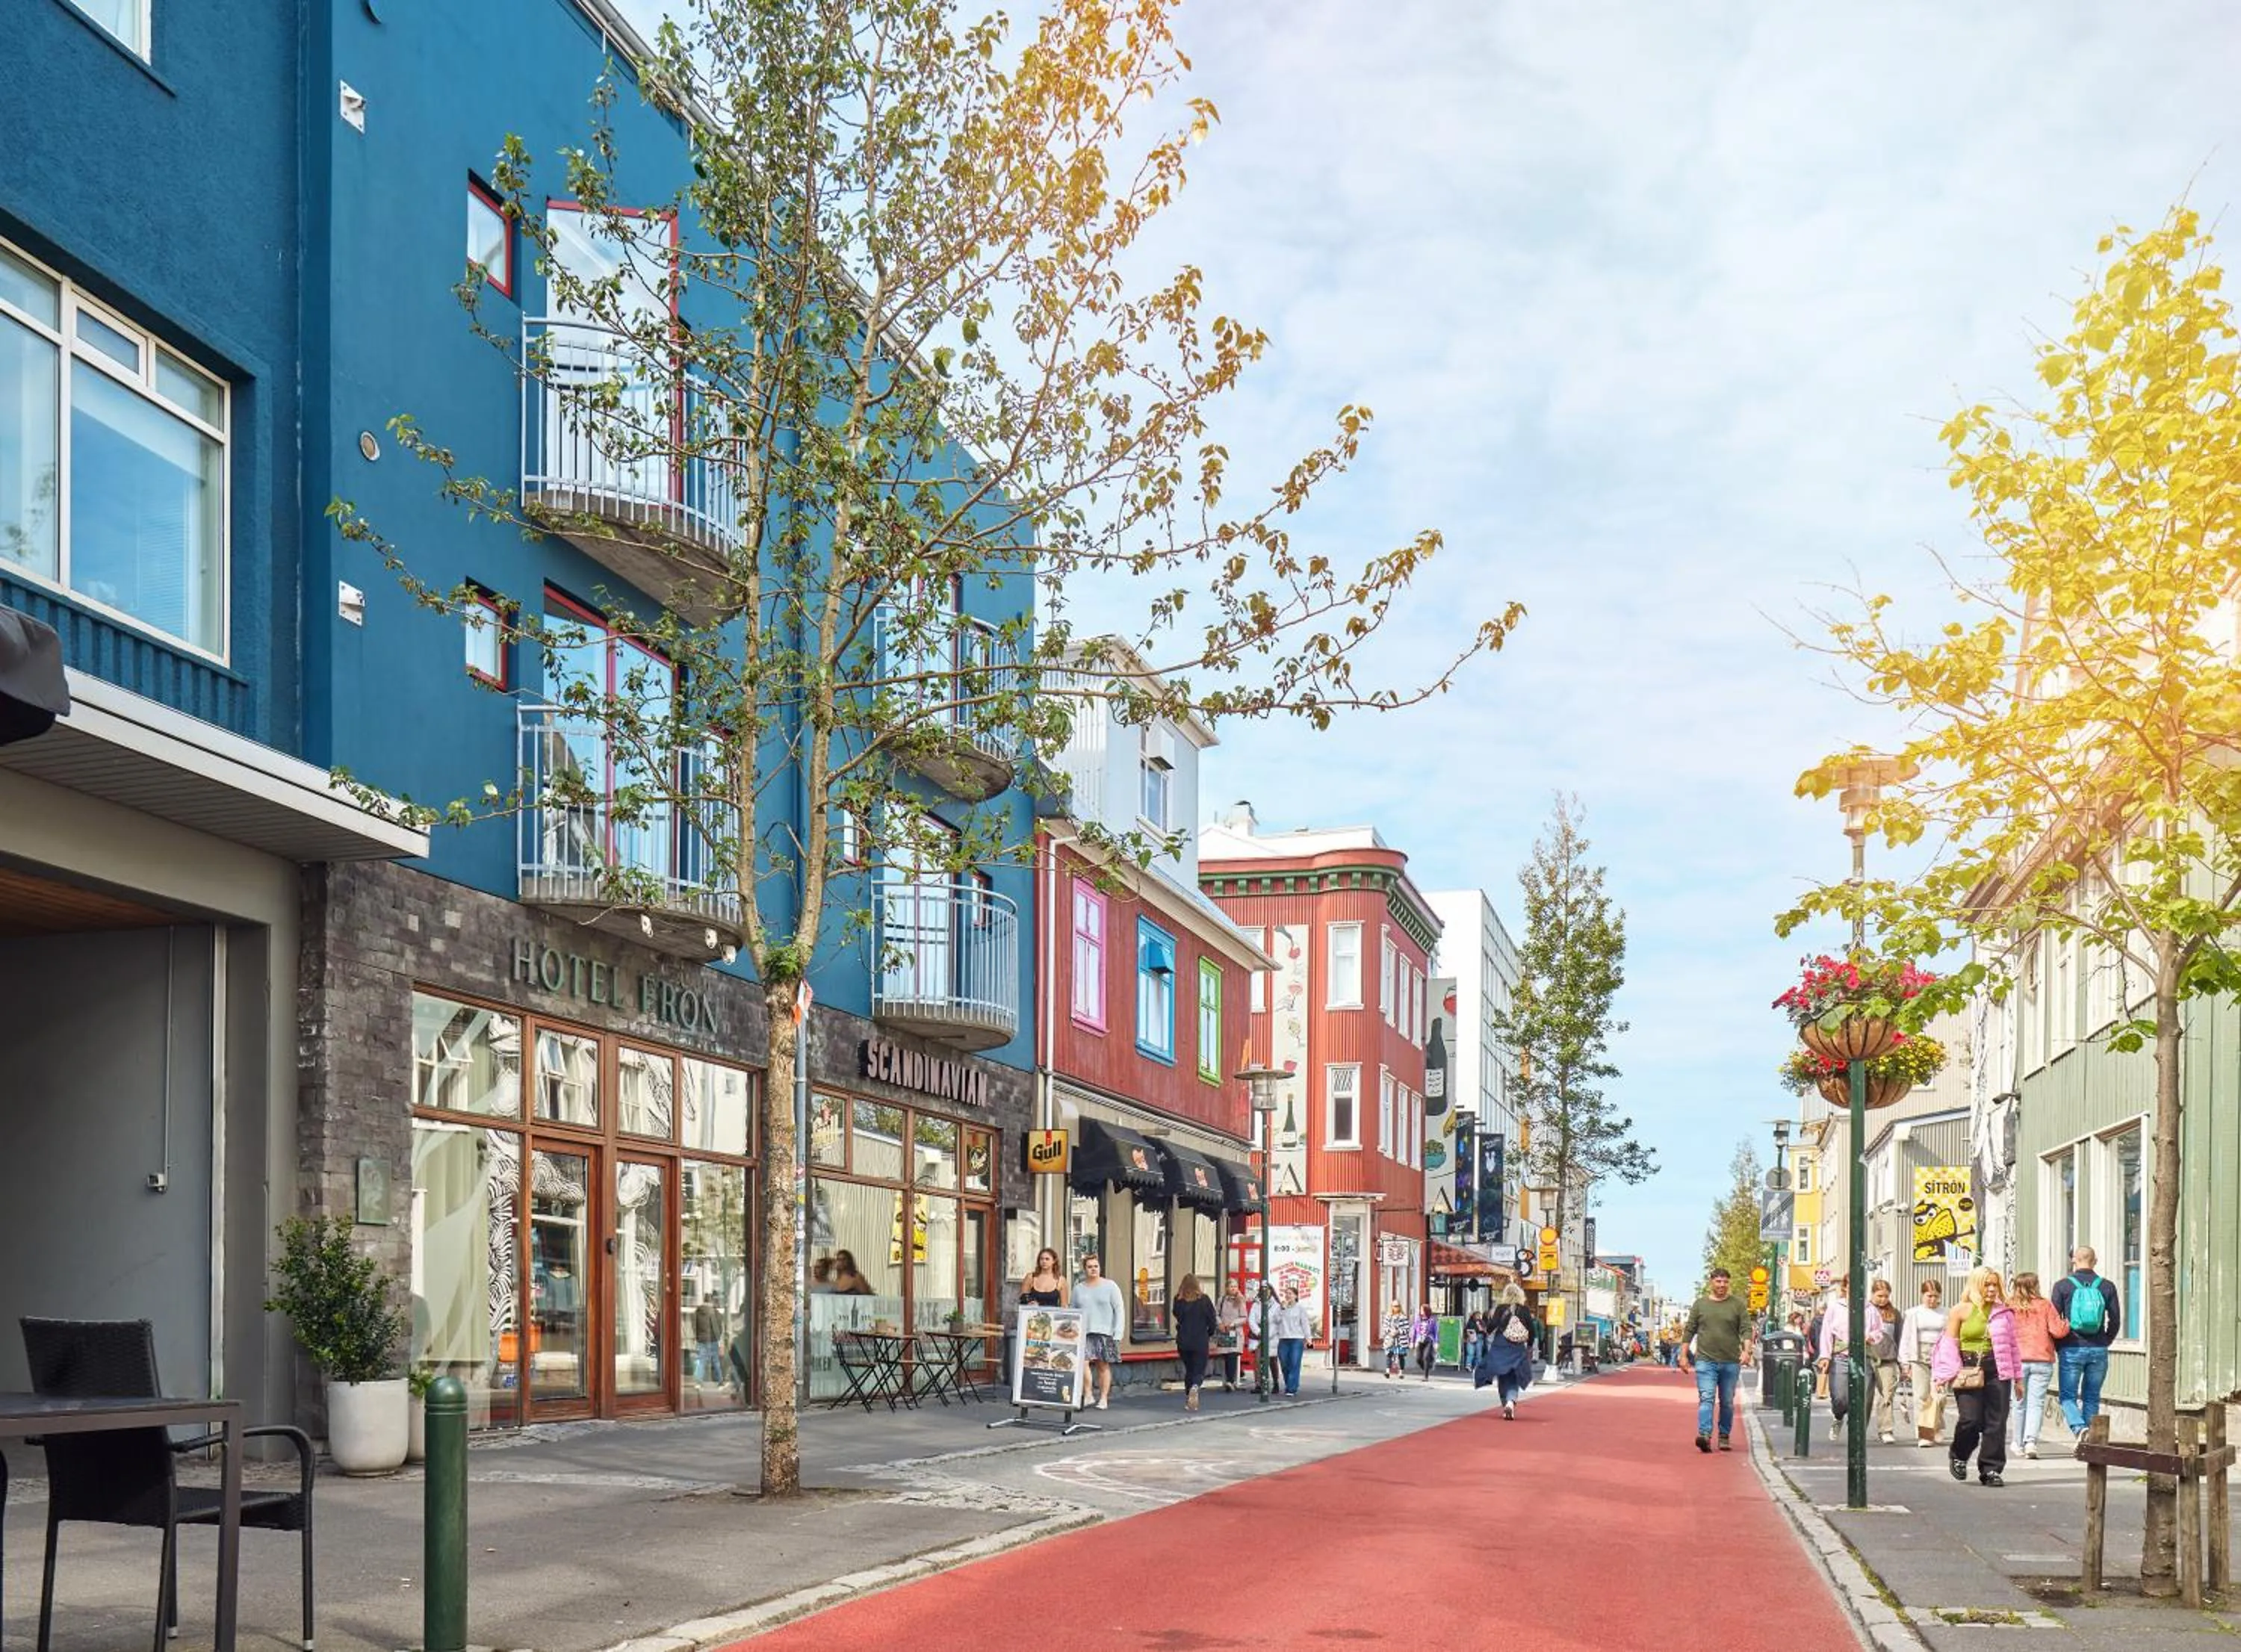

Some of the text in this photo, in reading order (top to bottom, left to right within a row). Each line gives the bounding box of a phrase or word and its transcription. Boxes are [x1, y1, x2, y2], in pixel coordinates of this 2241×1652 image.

[512, 937, 624, 1008] HOTEL
[866, 1039, 988, 1108] SCANDINAVIAN
[1032, 1140, 1061, 1161] Gull
